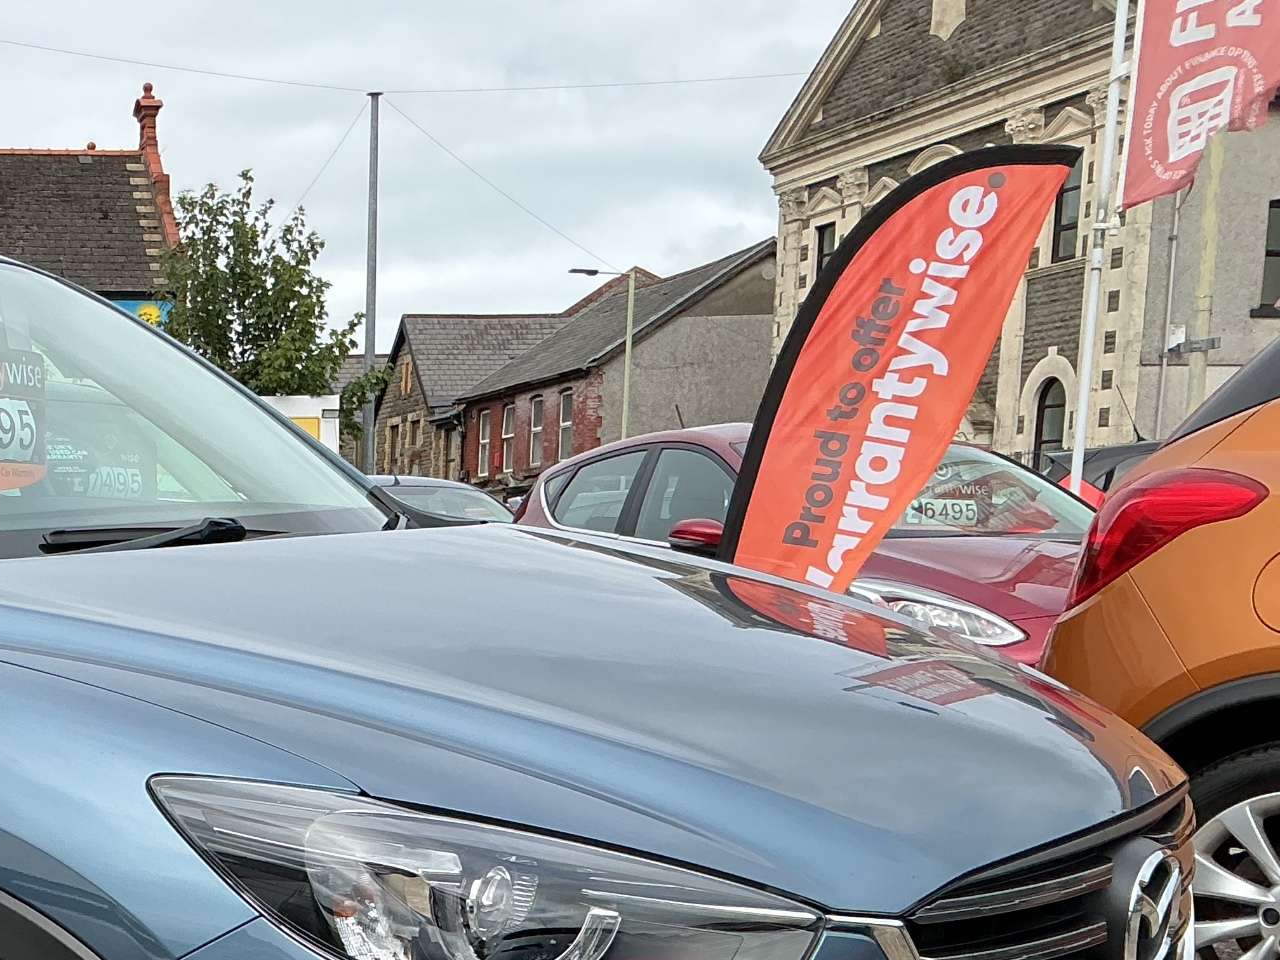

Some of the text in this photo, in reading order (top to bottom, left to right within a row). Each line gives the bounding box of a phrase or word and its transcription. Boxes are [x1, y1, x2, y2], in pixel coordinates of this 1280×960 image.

[1143, 101, 1158, 136] TODAY
[1156, 65, 1185, 100] ABOUT
[782, 429, 851, 549] Proud
[826, 380, 867, 422] to
[851, 276, 906, 373] offer
